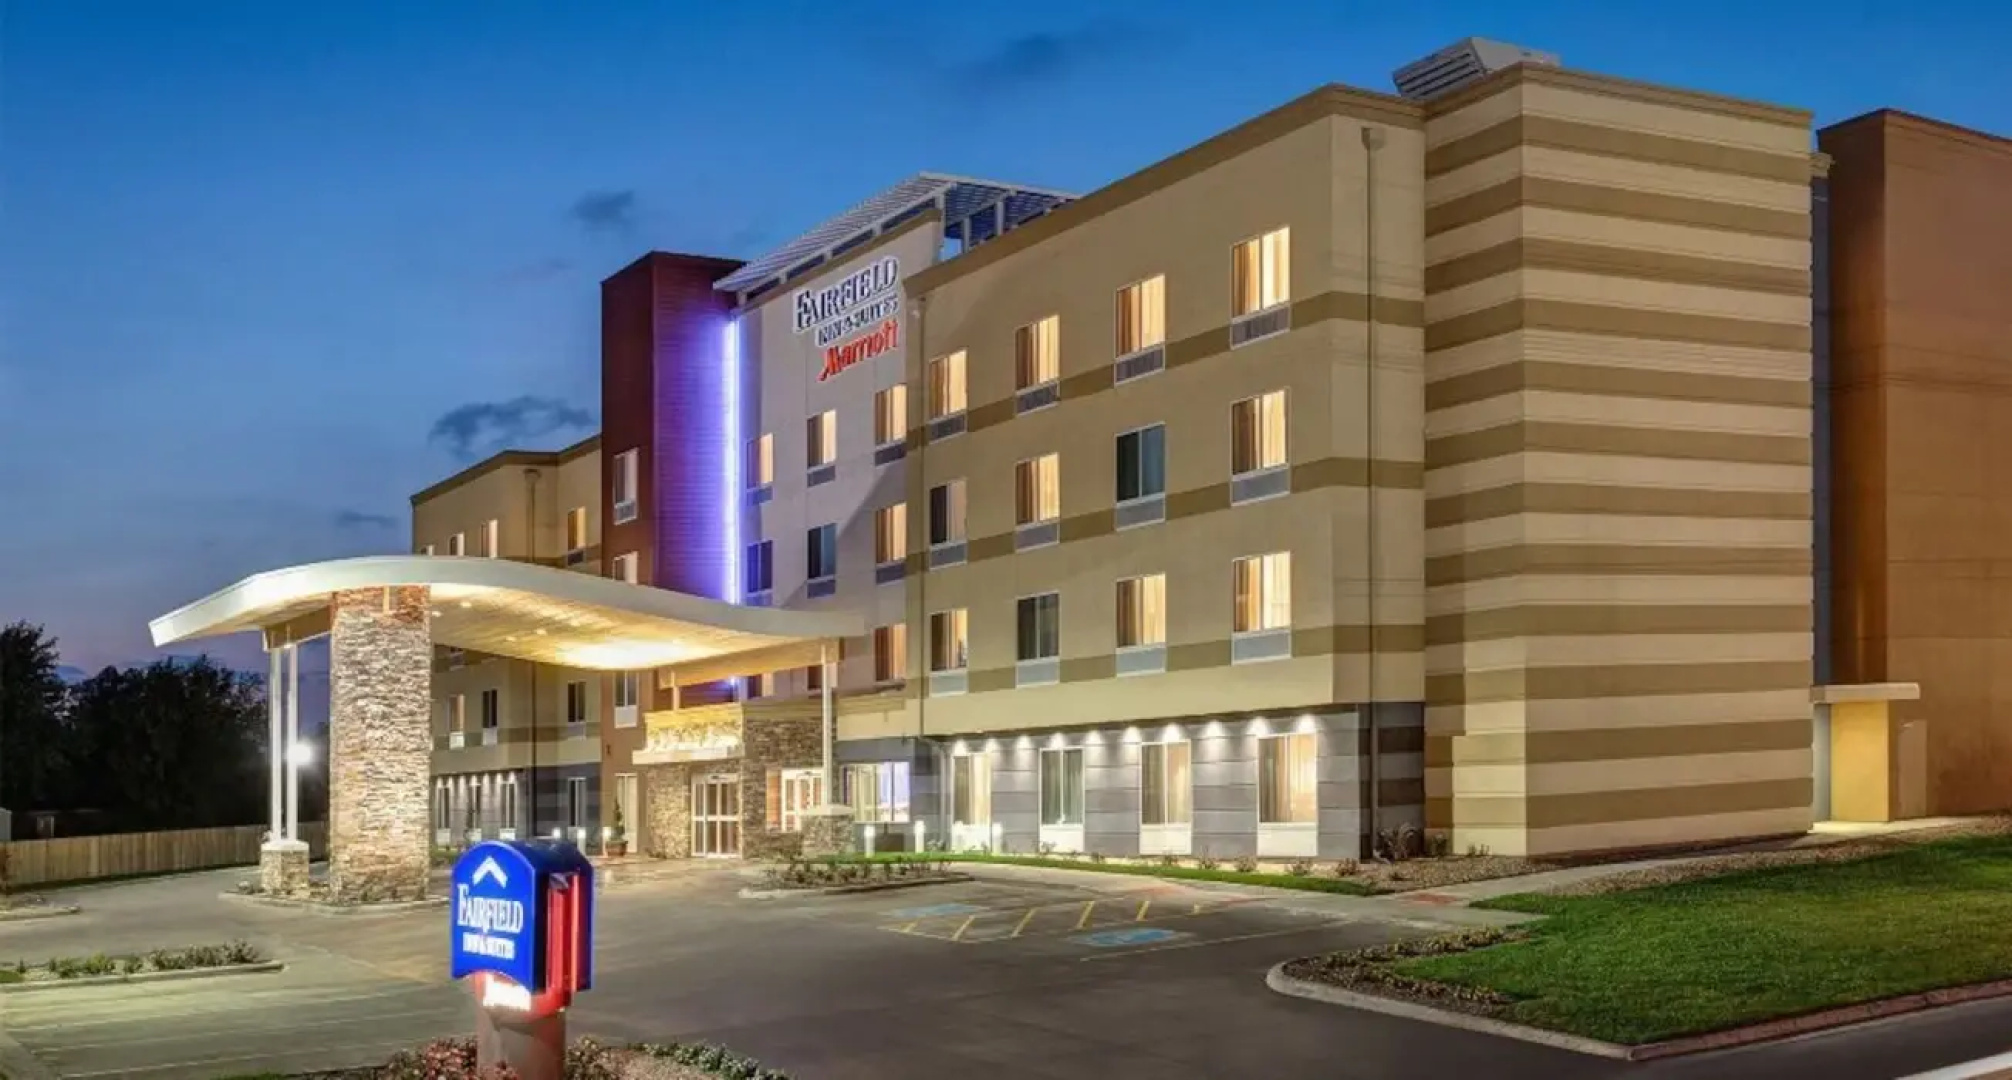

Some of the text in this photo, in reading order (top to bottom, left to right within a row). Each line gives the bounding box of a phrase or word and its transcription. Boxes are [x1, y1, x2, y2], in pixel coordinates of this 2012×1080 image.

[793, 257, 899, 334] FAIRFIELD
[815, 320, 841, 347] INN
[816, 318, 899, 381] Marriott
[457, 883, 524, 934] FAIRFIELD
